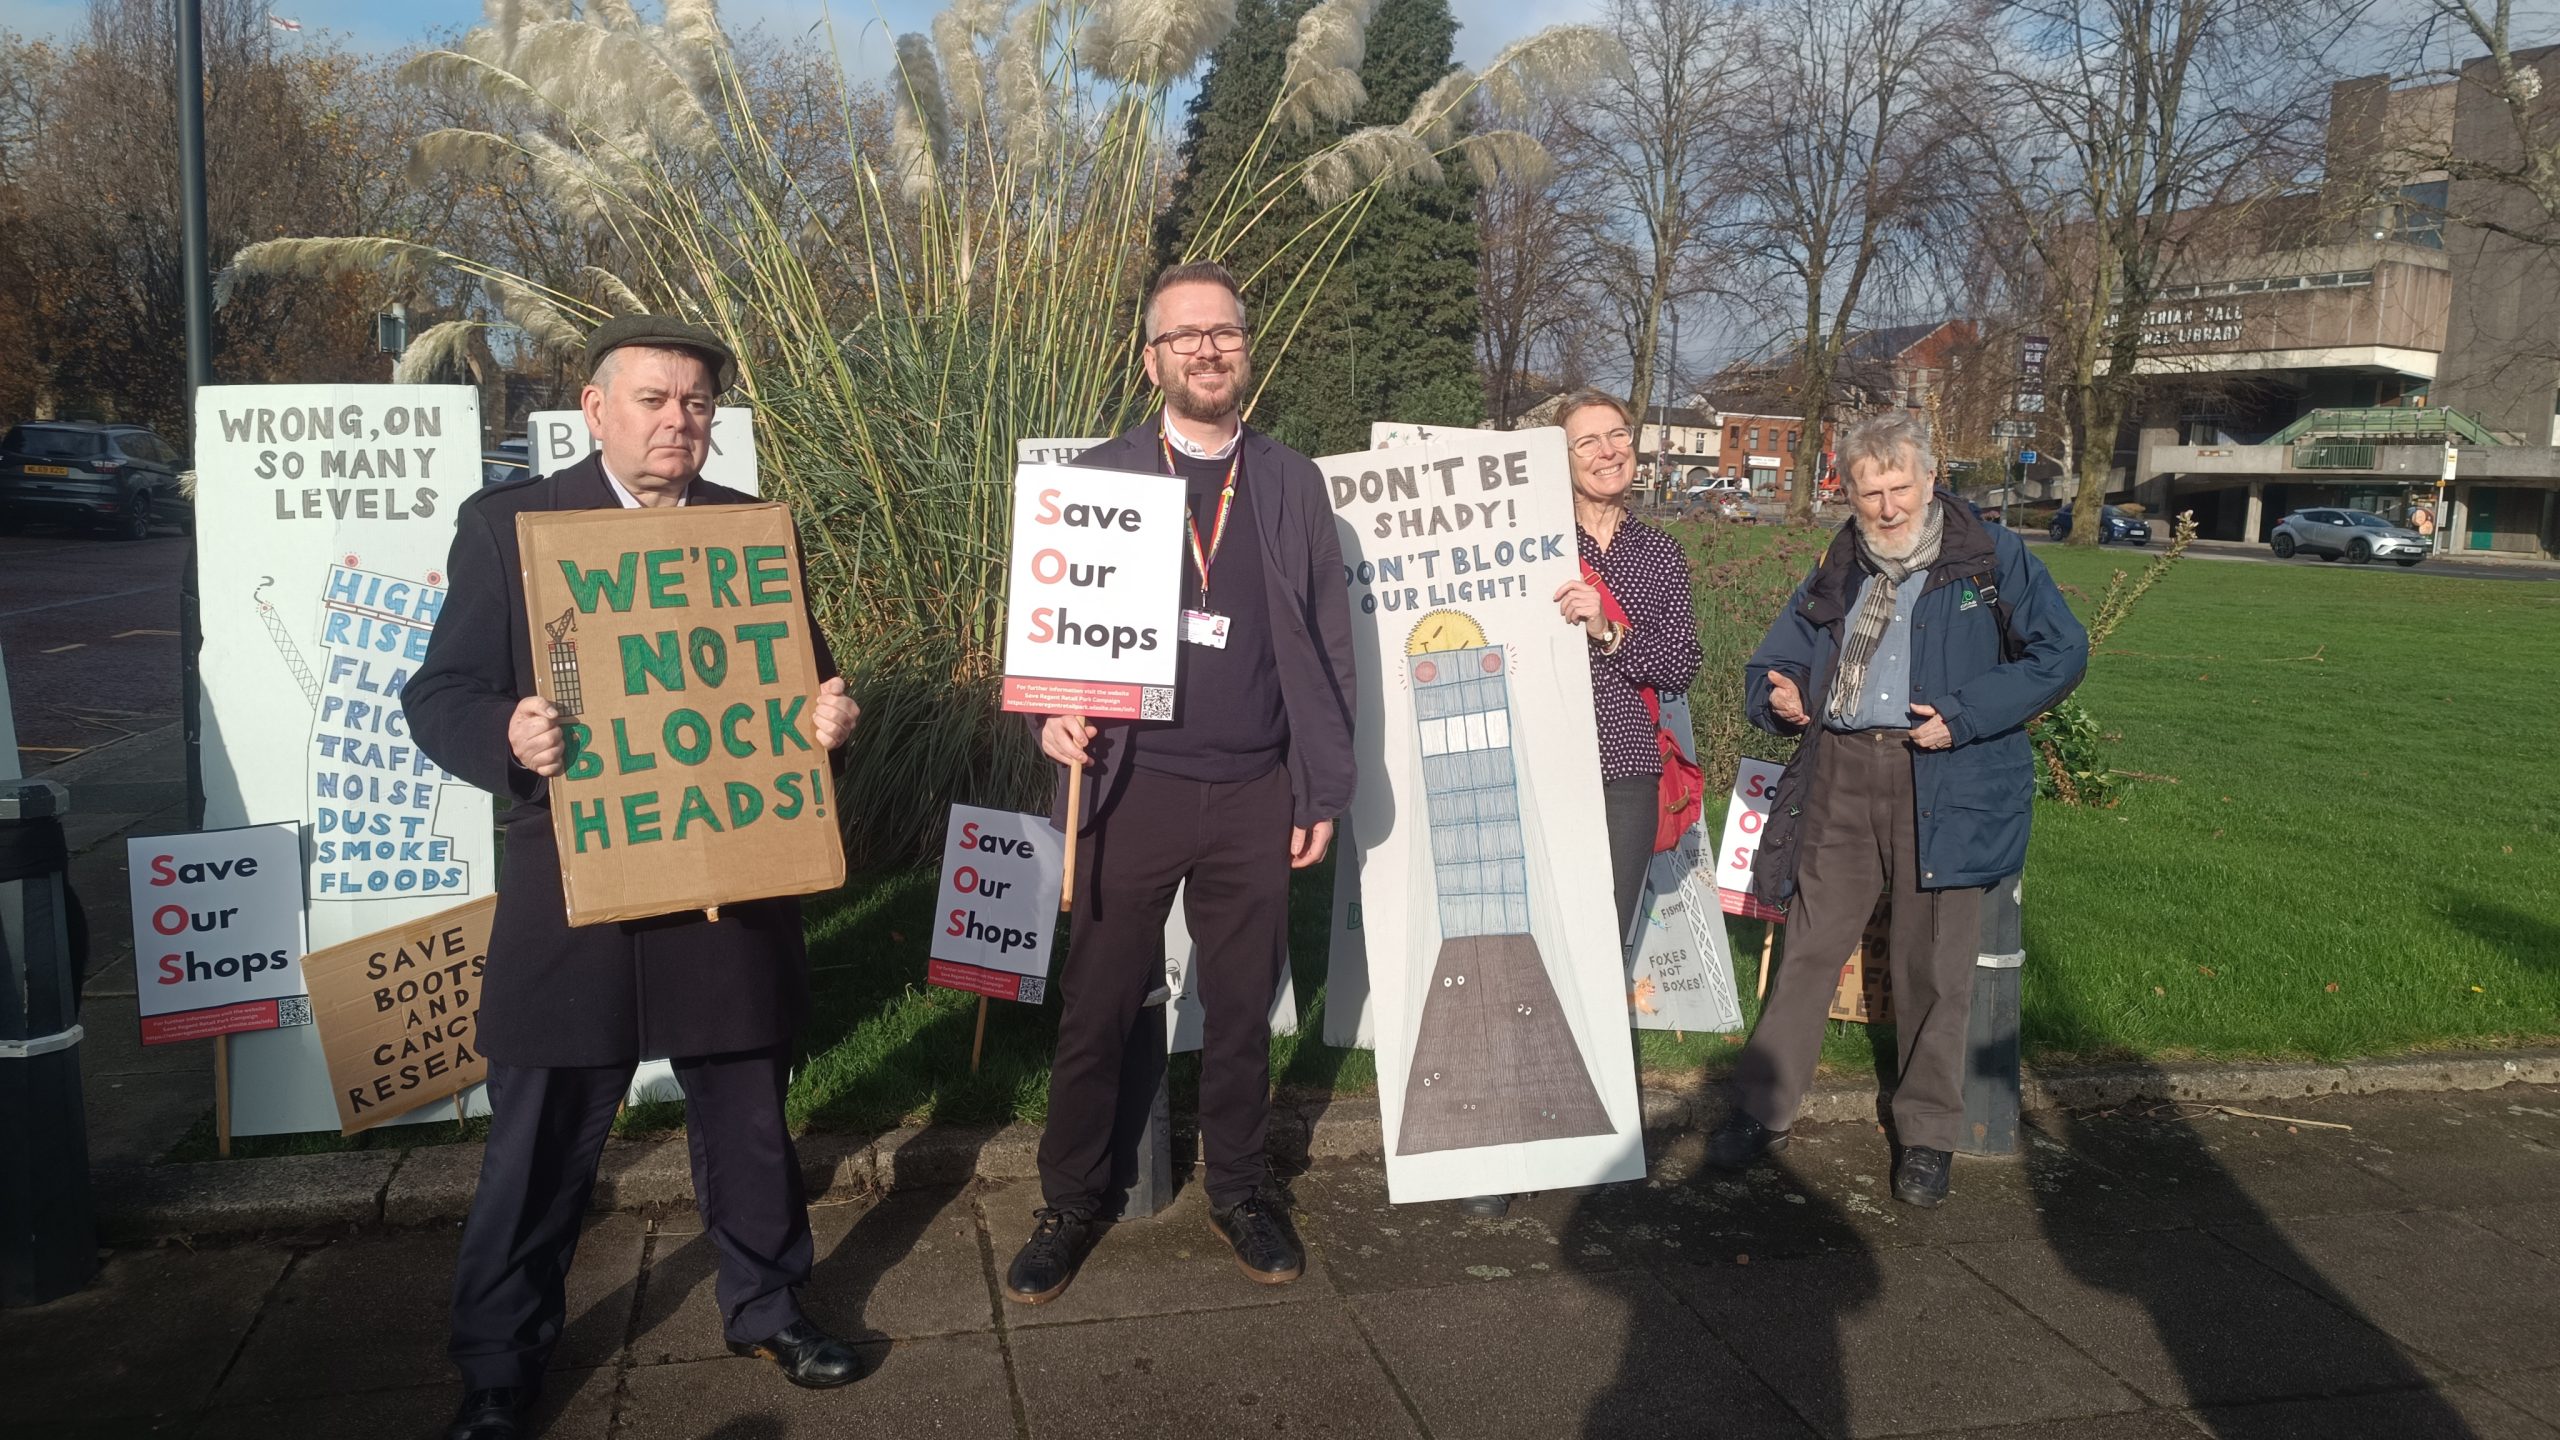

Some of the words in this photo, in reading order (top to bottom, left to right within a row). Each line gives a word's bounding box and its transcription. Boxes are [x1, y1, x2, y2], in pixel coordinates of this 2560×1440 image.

[2204, 305, 2243, 322] HALL
[2178, 325, 2243, 343] LIBRARY
[384, 406, 442, 437] ON
[254, 450, 305, 480] SO
[320, 448, 436, 480] MANY
[1330, 456, 1464, 509] DON'T
[1478, 450, 1529, 491] BE
[275, 487, 439, 521] LEVELS
[1034, 488, 1142, 532] Save
[1373, 499, 1517, 539] SHADY!
[1031, 548, 1117, 588] Our
[1451, 534, 1565, 576] BLOCK
[328, 569, 444, 623] HIGH
[557, 545, 792, 614] WE'RE
[1360, 588, 1419, 615] OUR
[1428, 574, 1527, 607] LIGHT!
[325, 612, 432, 663] RISE
[1027, 607, 1158, 659] Shops
[618, 621, 789, 696] NOT
[321, 696, 413, 739] PRIC
[559, 695, 813, 781] BLOCK
[317, 772, 433, 809] NOISE
[318, 808, 425, 838] DUST
[570, 769, 827, 854] HEADS!
[318, 840, 448, 863] SMOKE
[959, 822, 1035, 859] Save
[1685, 848, 1708, 860] BUZZ
[149, 854, 258, 886] Save
[1690, 857, 1709, 867] OFF!
[320, 868, 463, 894] FLOODS
[953, 866, 1012, 899] Our
[152, 904, 239, 936] Our
[945, 909, 1038, 954] Shops
[158, 949, 289, 985] Shops
[366, 926, 466, 981] SAVE
[1649, 949, 1687, 969] FOXES
[1659, 965, 1682, 978] NOT
[373, 955, 487, 1013] BOOTS
[1662, 973, 1705, 992] BOXES!
[407, 989, 470, 1030] AND
